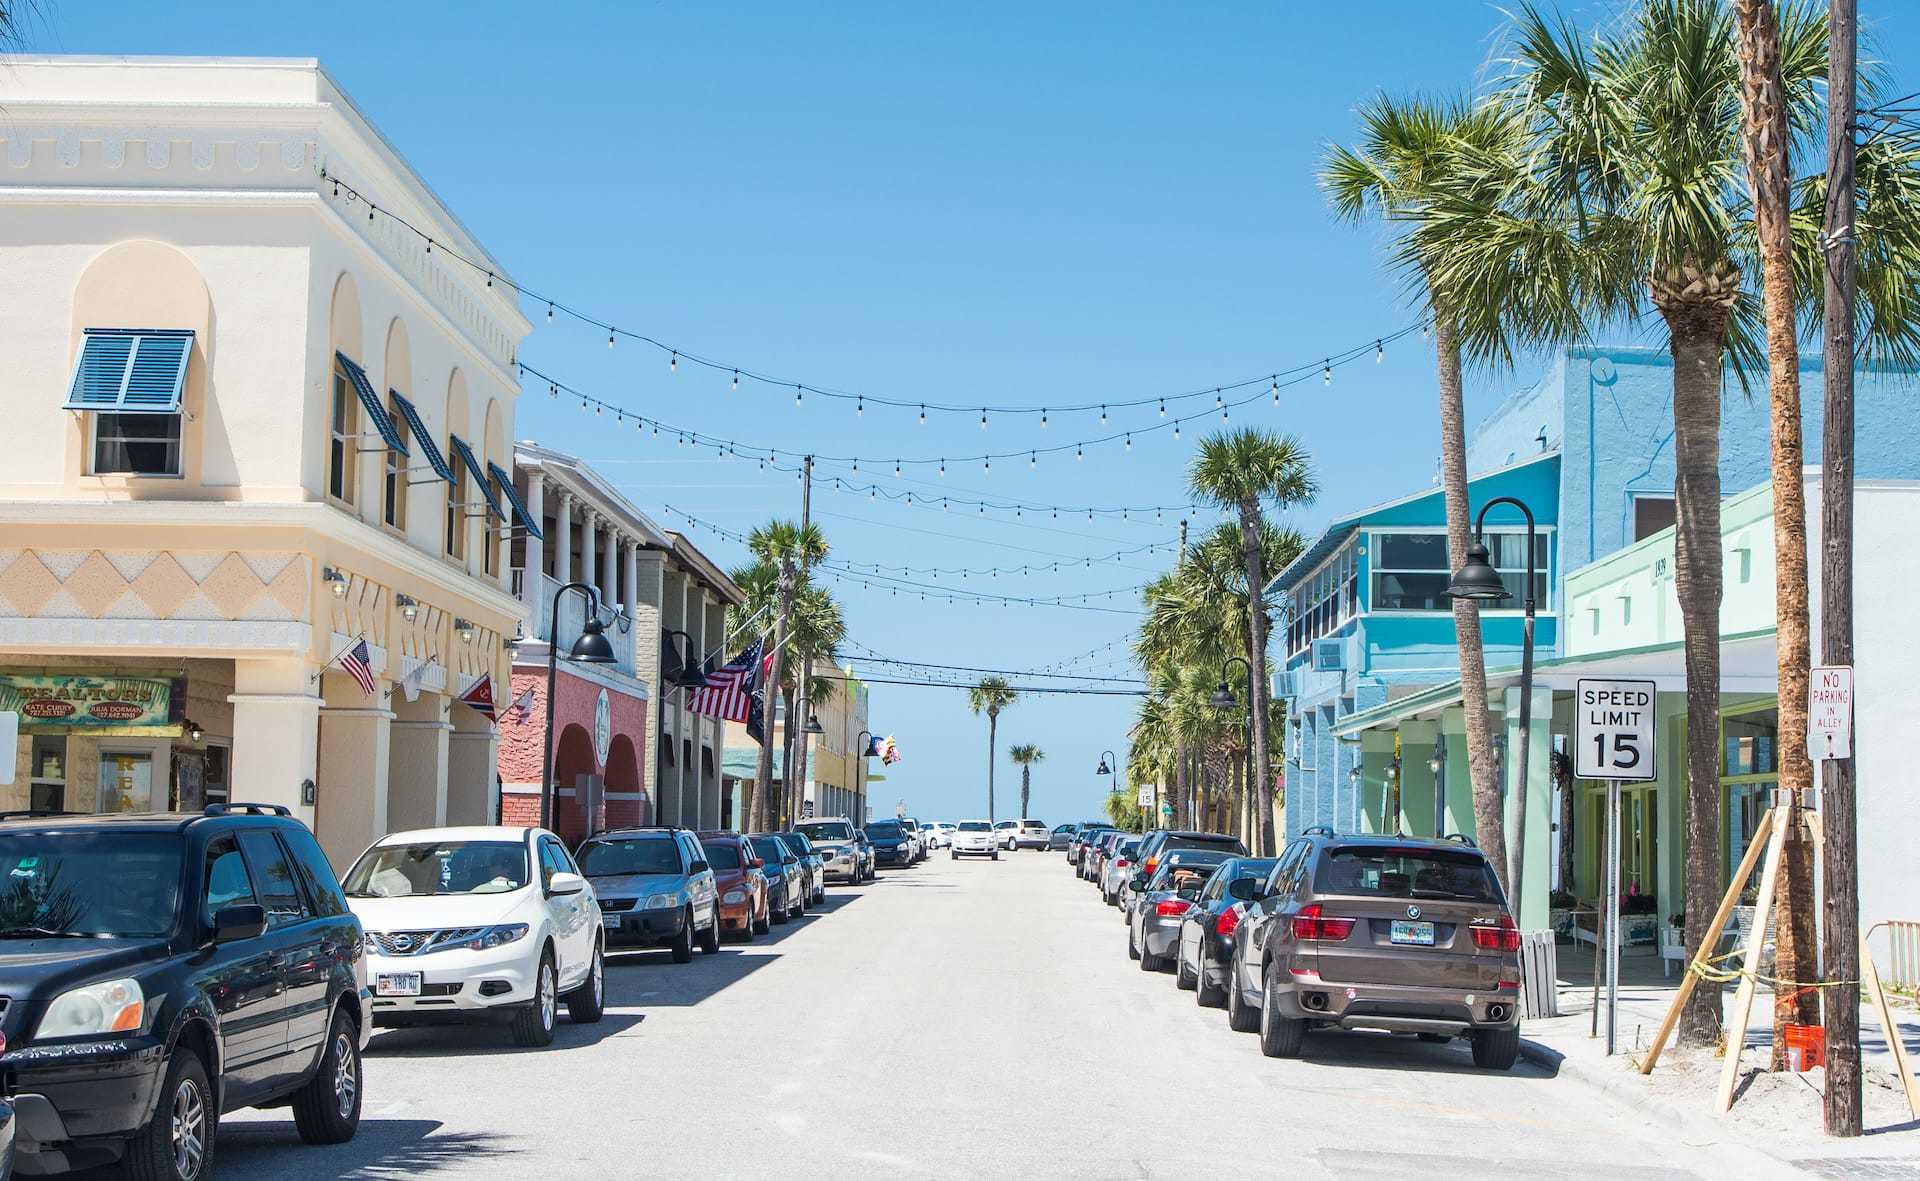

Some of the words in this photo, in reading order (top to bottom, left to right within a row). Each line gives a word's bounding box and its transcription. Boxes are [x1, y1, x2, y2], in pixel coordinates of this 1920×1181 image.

[1655, 557, 1667, 578] 1939
[1823, 674, 1839, 688] NO
[17, 687, 152, 702] REALTORS
[1584, 691, 1649, 706] SPEED
[1813, 690, 1848, 704] PARKING
[1827, 706, 1835, 716] IN
[1591, 711, 1641, 727] LIMIT
[1817, 719, 1842, 729] ALLEY
[1594, 733, 1640, 769] 15
[1142, 795, 1151, 804] 15
